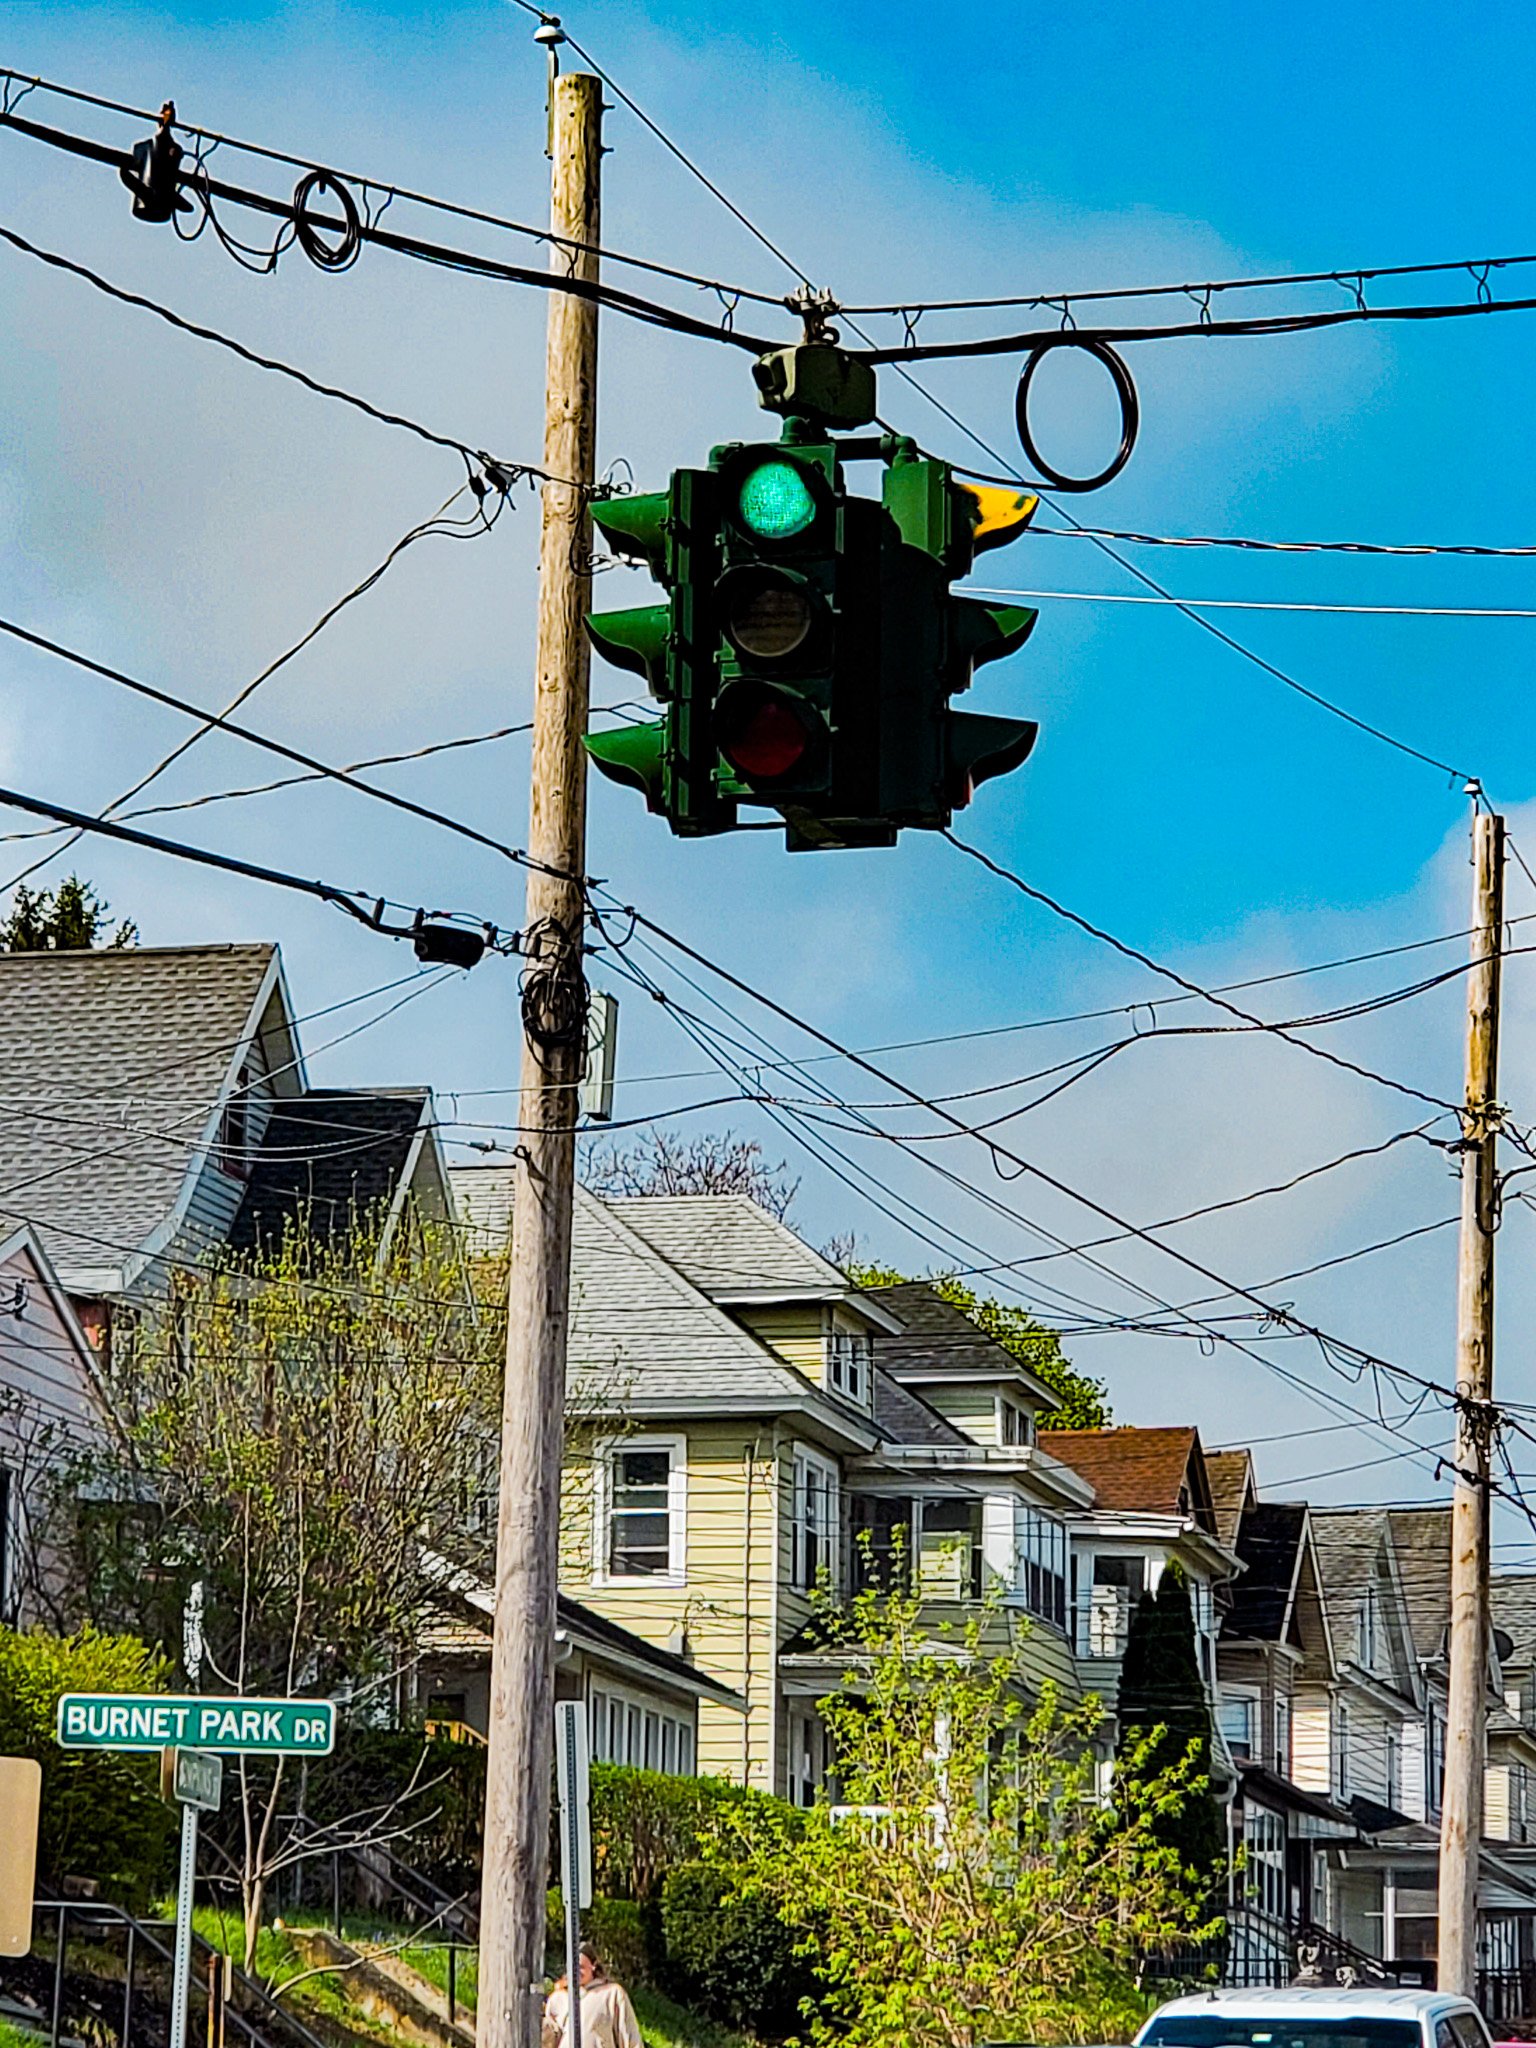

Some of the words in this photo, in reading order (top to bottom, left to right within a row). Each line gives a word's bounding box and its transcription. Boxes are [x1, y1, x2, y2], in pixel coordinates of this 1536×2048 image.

[67, 1706, 189, 1738] BURNET
[200, 1710, 282, 1742] PARK
[294, 1719, 326, 1743] DR
